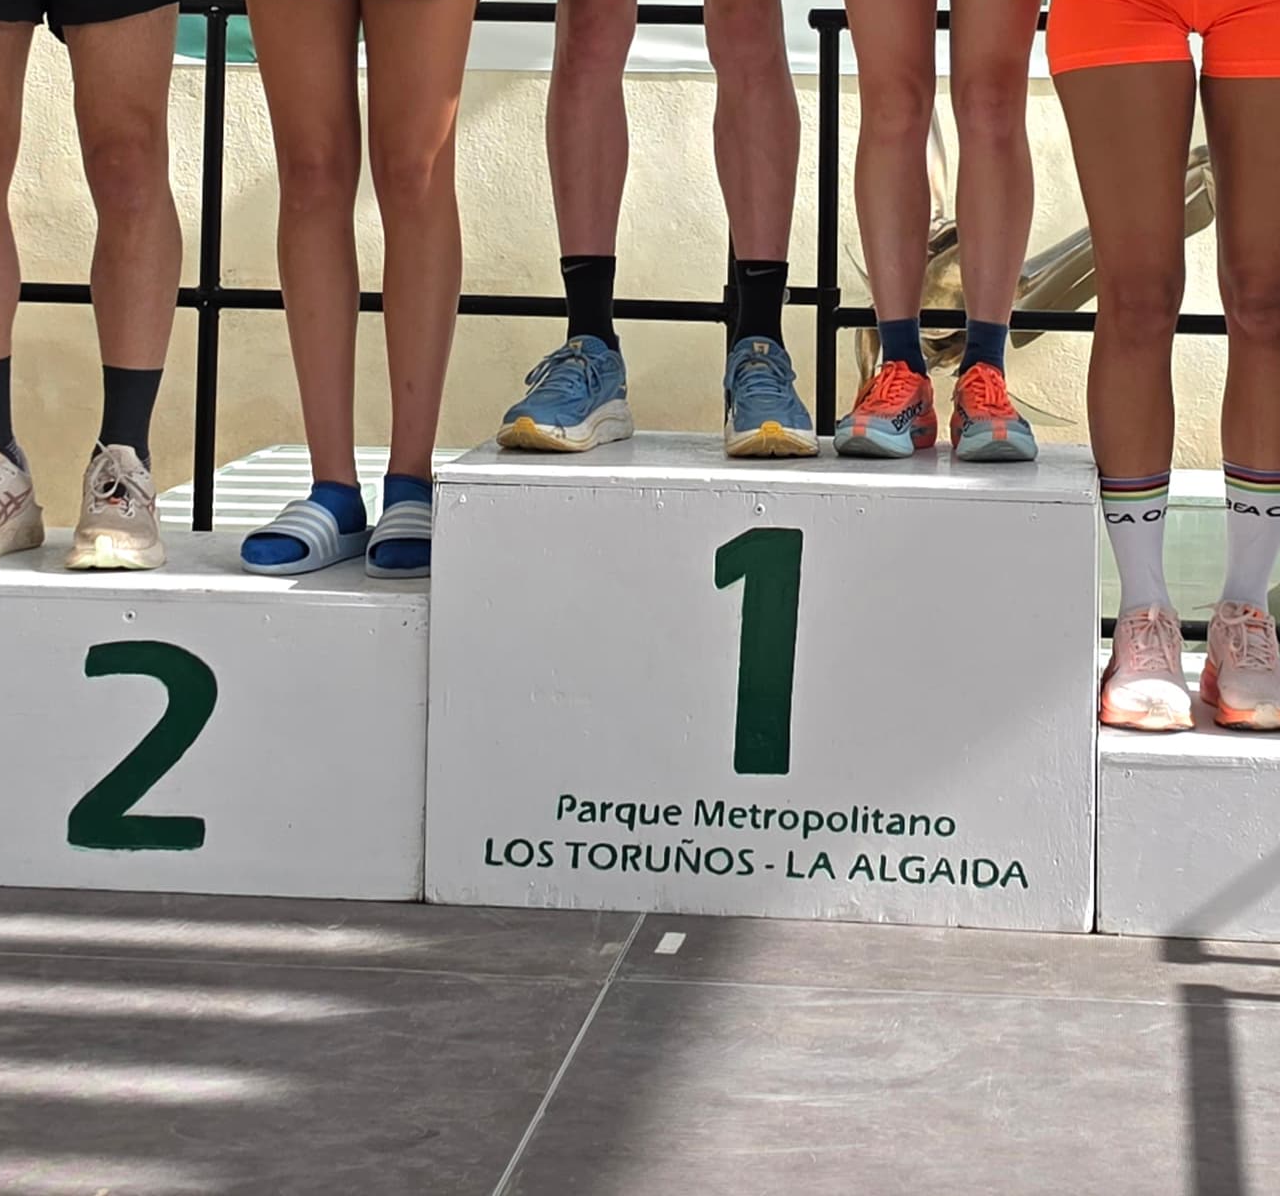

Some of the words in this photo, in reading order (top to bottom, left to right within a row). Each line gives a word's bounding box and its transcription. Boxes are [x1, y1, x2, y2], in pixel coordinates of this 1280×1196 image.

[715, 527, 803, 775] 1
[67, 640, 218, 851] 2
[483, 837, 554, 869] LOS
[565, 838, 755, 876] TORUÑOS
[786, 849, 836, 881] LA
[847, 852, 1030, 890] ALGAIDA
[556, 793, 683, 831] Parque
[693, 799, 957, 840] Metropolitano
